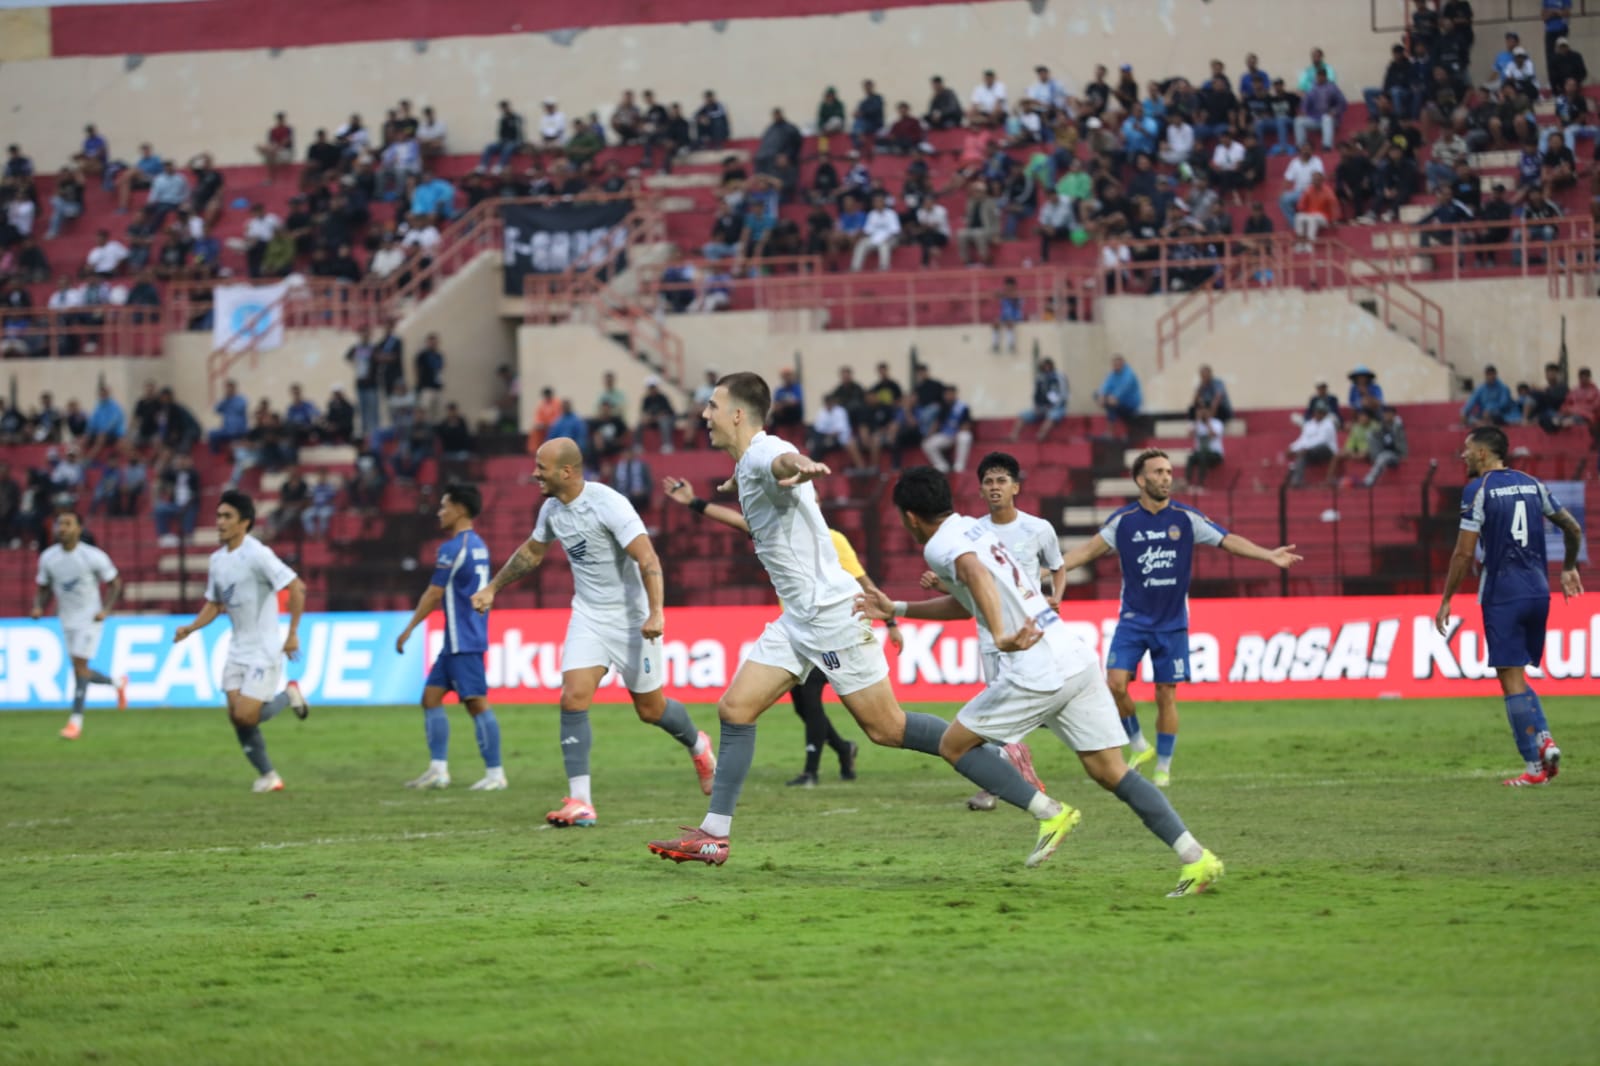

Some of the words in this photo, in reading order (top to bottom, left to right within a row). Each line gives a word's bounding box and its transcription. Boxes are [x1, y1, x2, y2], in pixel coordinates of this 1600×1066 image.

[1511, 500, 1528, 547] 4
[1137, 545, 1177, 563] Adem
[822, 651, 841, 670] 99
[1228, 618, 1400, 683] ROSA!
